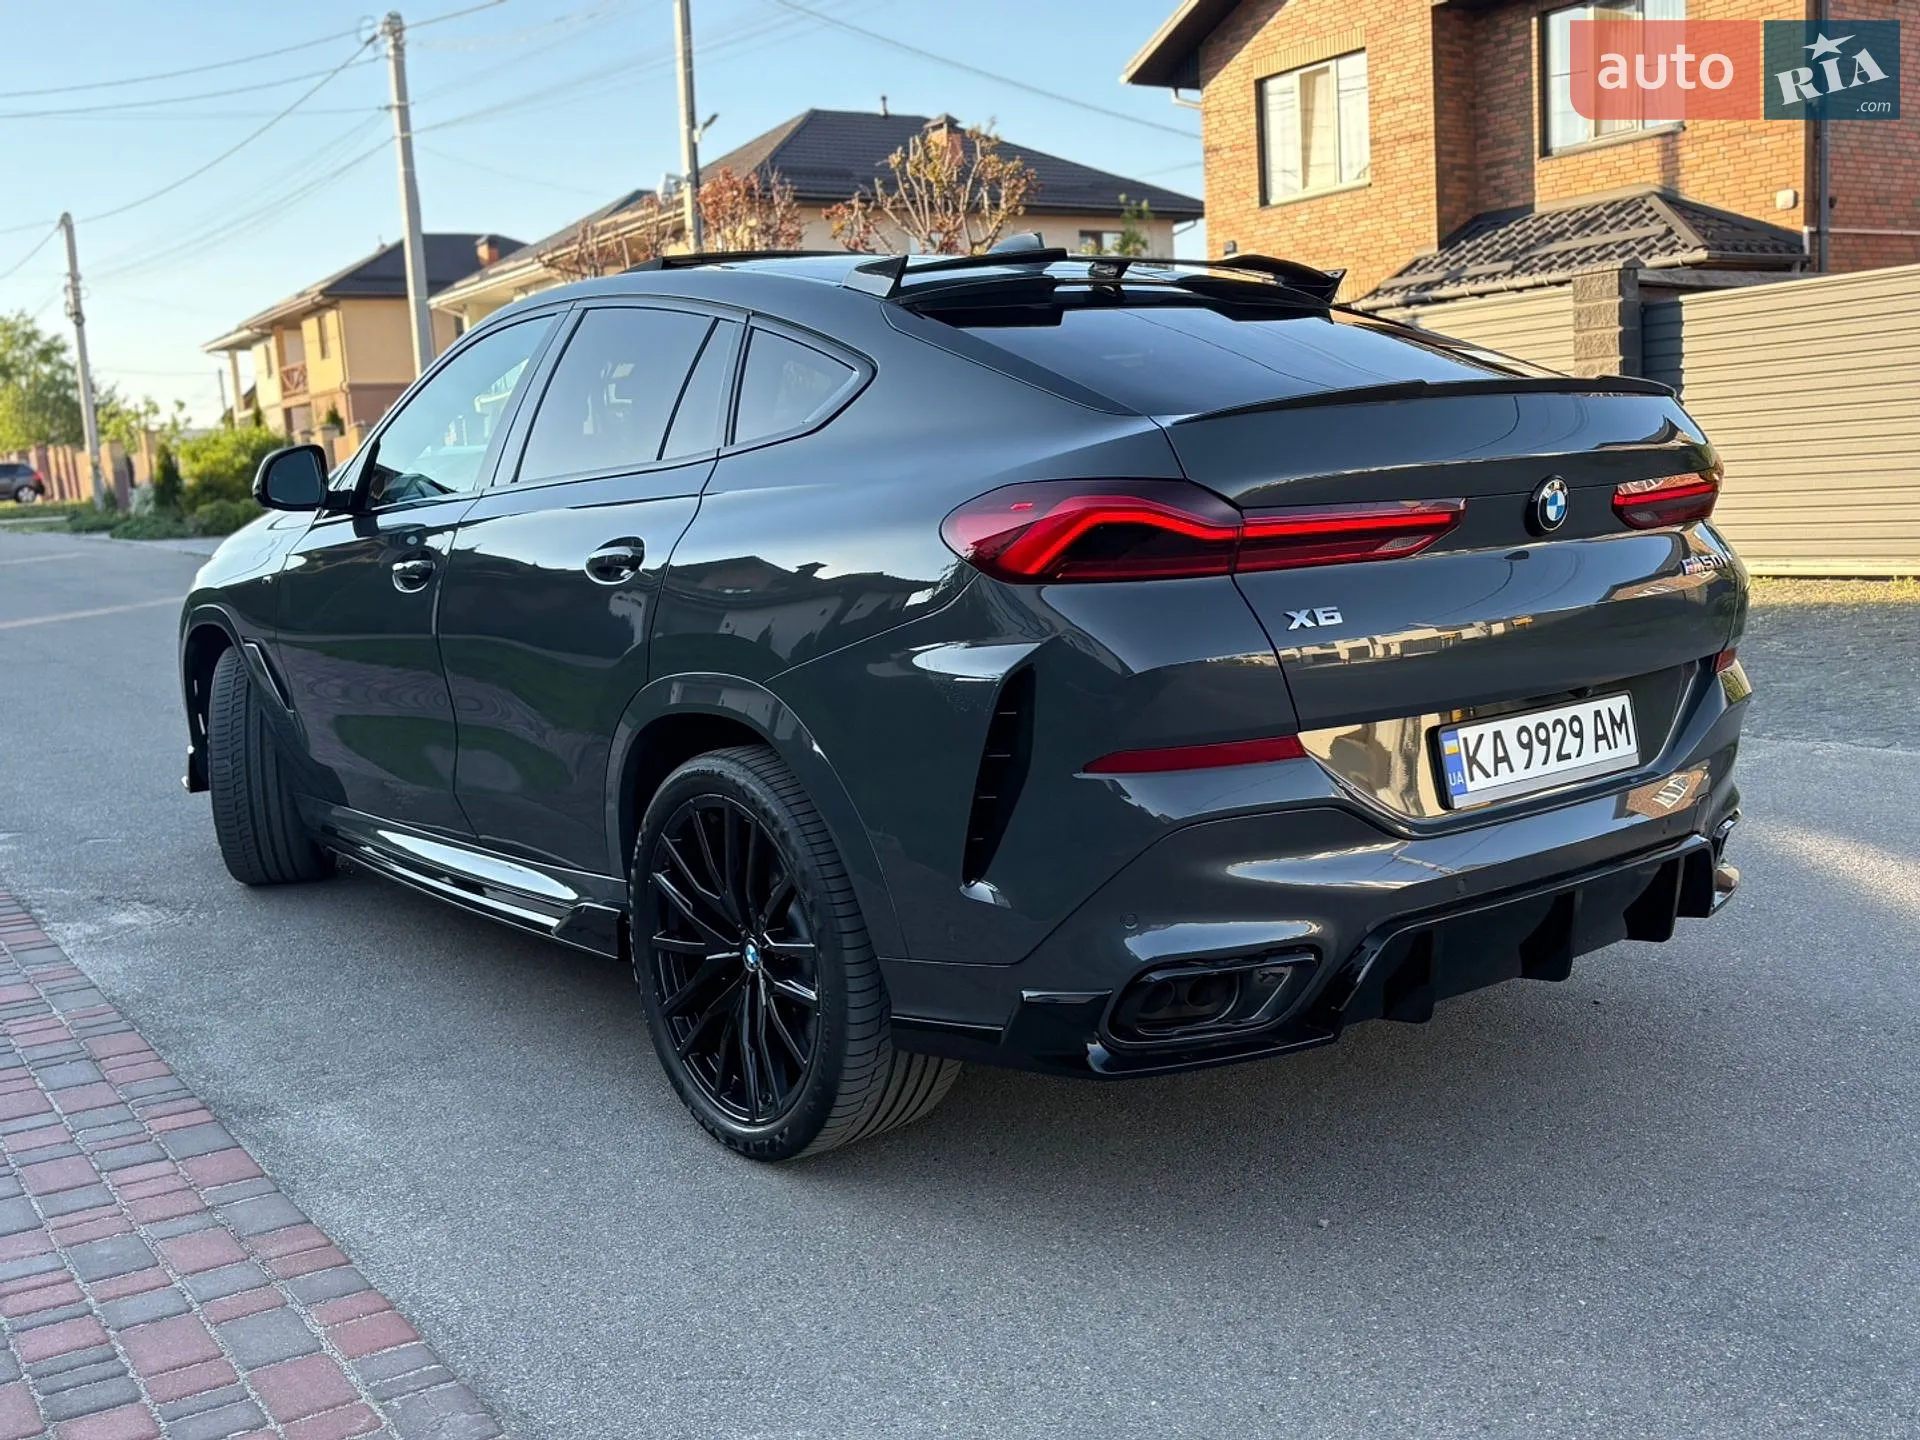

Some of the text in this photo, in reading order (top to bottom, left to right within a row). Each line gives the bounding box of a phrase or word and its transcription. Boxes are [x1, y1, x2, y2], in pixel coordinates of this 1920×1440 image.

[1284, 607, 1343, 630] X6
[1462, 704, 1631, 783] KA 9929 AM
[1449, 771, 1464, 786] UA
